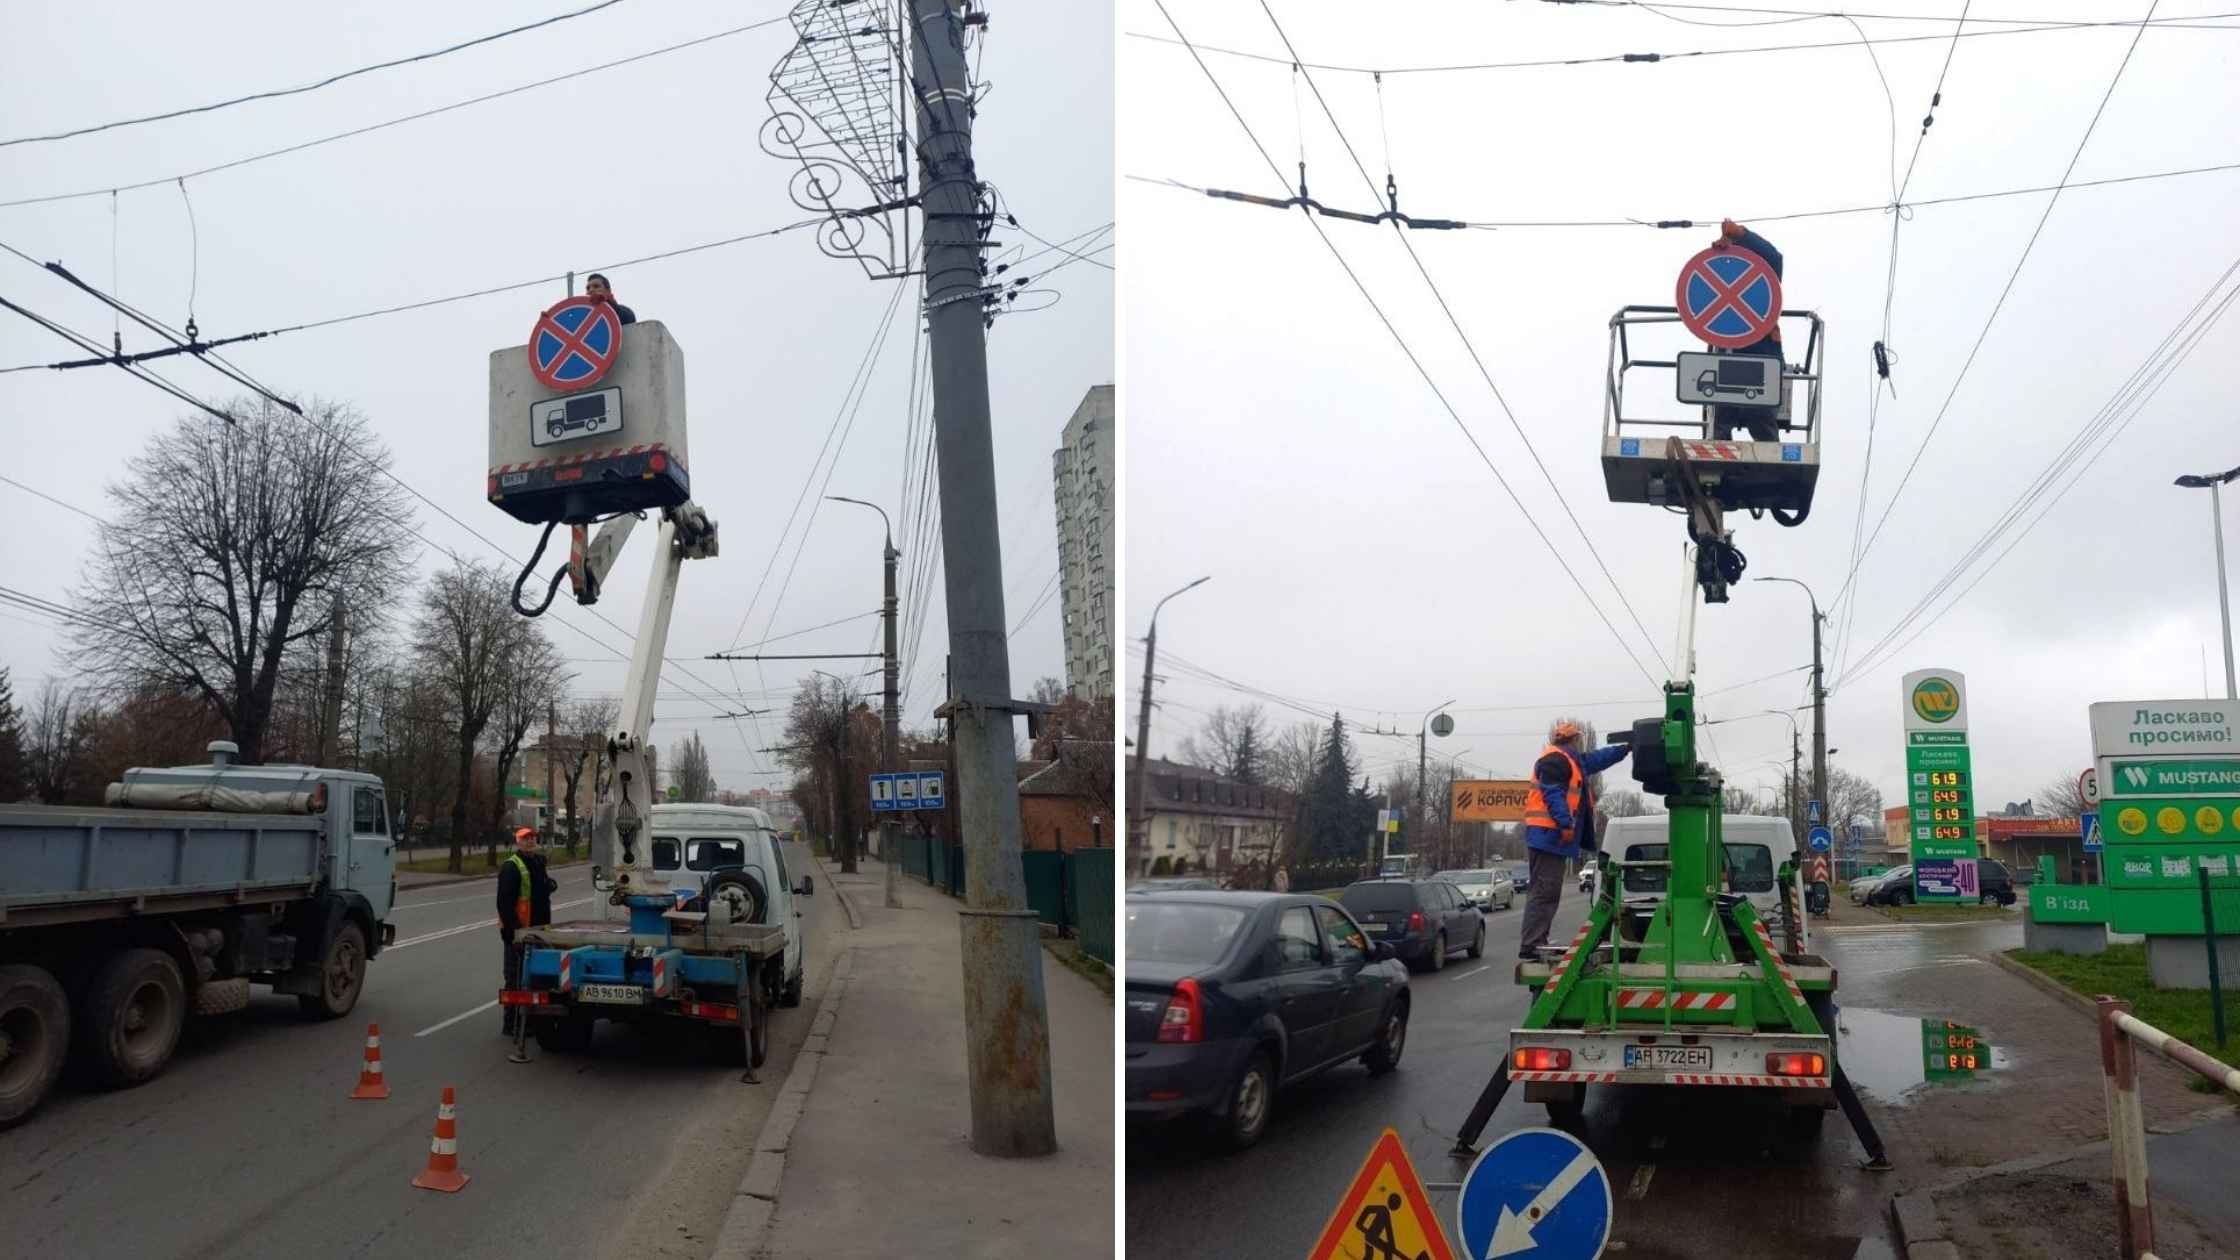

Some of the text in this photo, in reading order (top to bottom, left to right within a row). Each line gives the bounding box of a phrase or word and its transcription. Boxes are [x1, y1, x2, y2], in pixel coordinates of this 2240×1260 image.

[2133, 709, 2224, 725] Ласкаво
[2129, 727, 2232, 747] просимо!
[2158, 771, 2240, 785] MUSTANG
[1656, 1049, 1686, 1064] 3722
[1688, 1050, 1707, 1065] EH
